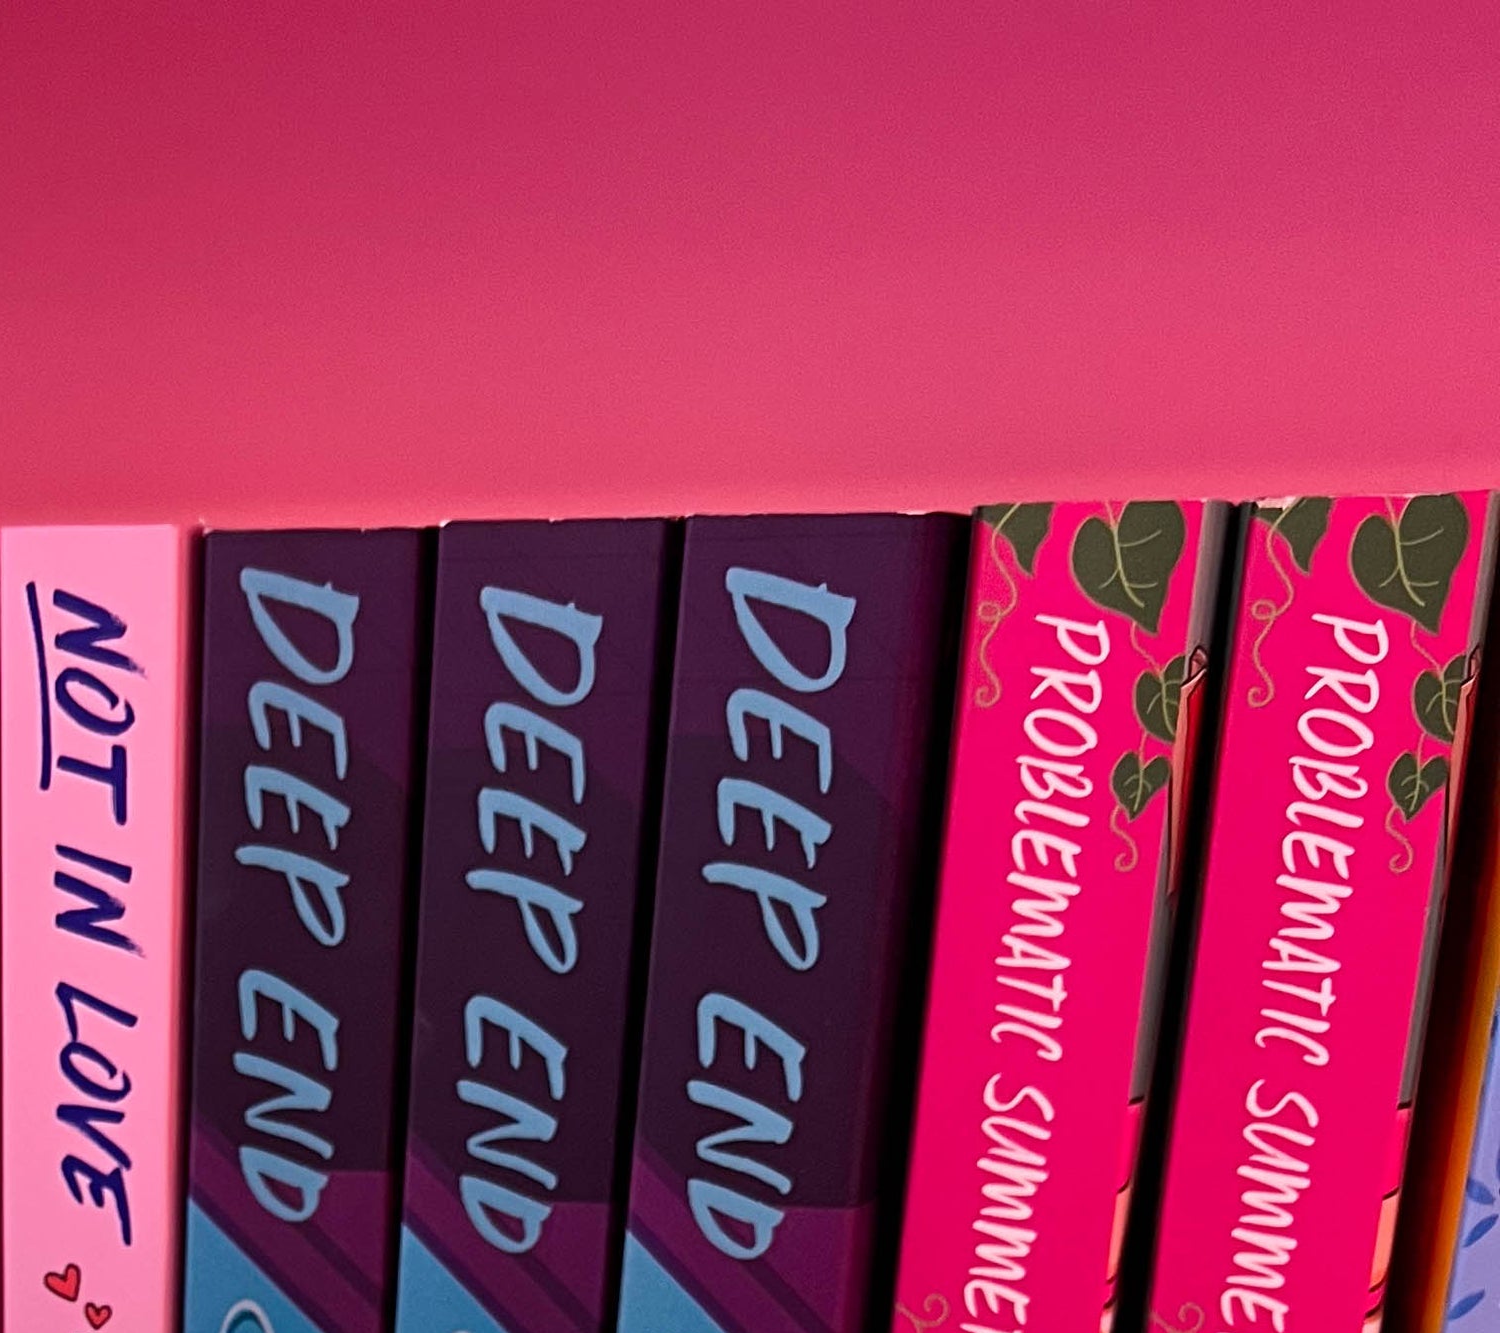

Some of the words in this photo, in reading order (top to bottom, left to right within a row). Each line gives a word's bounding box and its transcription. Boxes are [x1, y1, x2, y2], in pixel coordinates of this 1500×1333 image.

[52, 587, 149, 826] NOT
[234, 566, 360, 947] DEEP
[464, 585, 603, 975] DEEP
[701, 565, 857, 973] DEEP
[988, 611, 1111, 1063] PROBLEMATIC
[1254, 611, 1390, 1068] PROBLEMATIC
[53, 843, 146, 959] IN
[55, 981, 139, 1248] LOVE
[232, 968, 340, 1223] END
[455, 994, 568, 1255] END
[686, 991, 807, 1262] END
